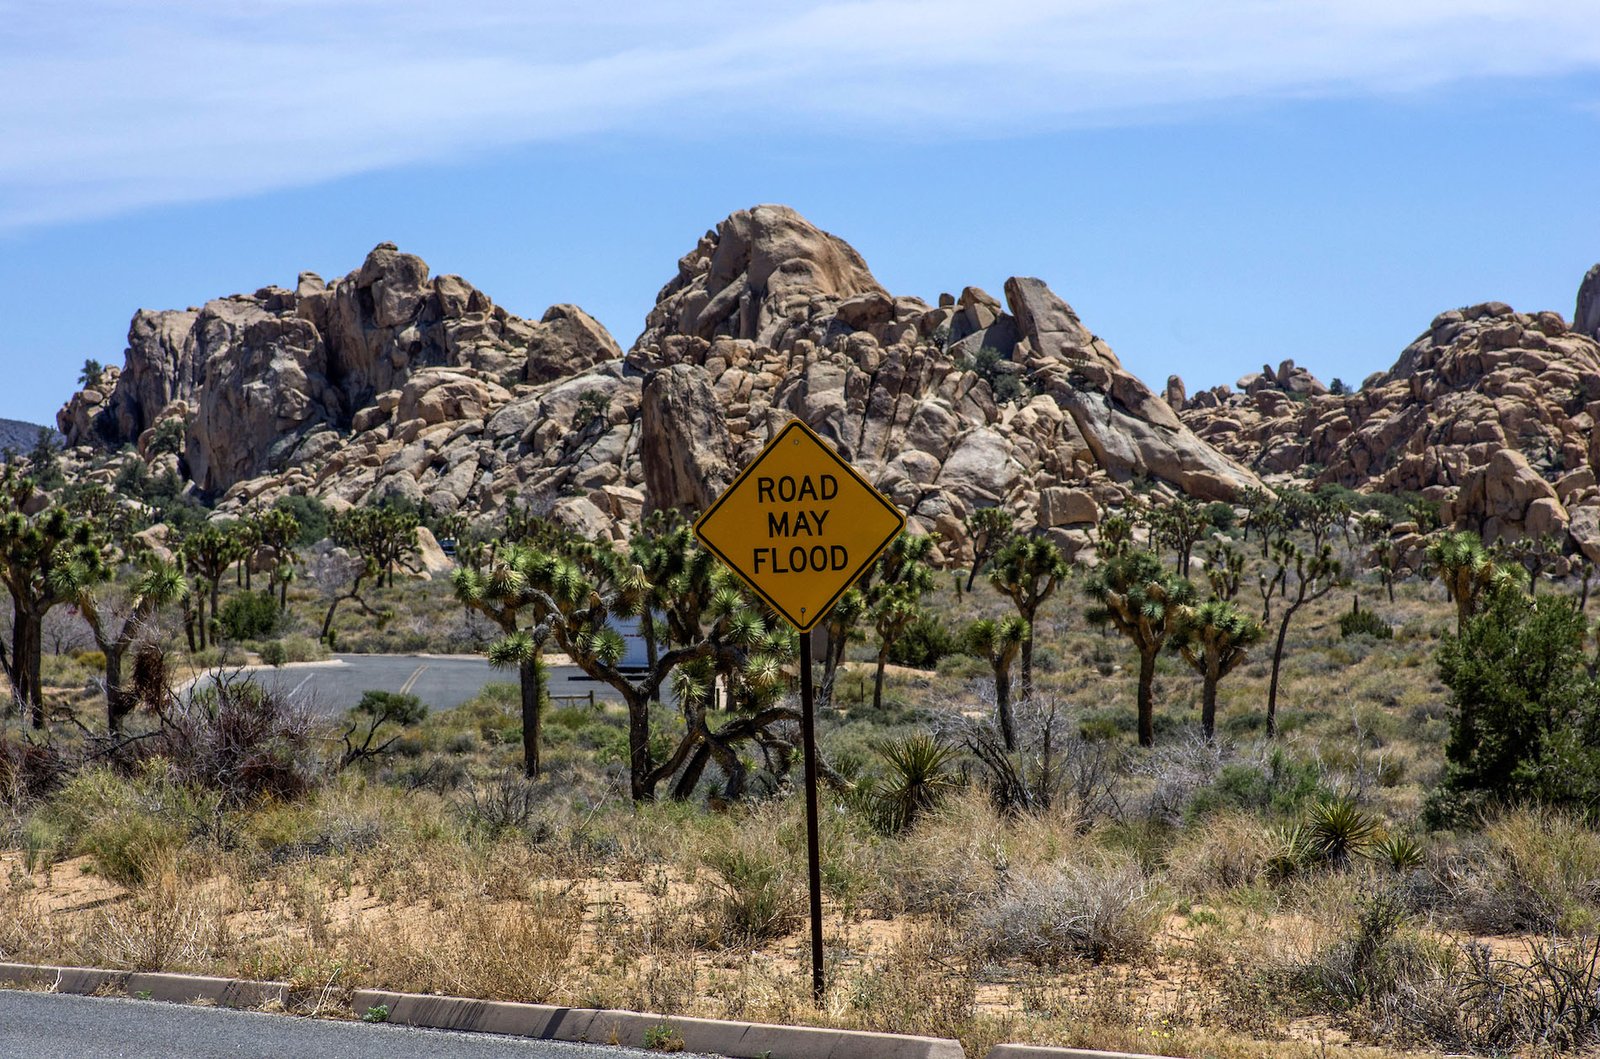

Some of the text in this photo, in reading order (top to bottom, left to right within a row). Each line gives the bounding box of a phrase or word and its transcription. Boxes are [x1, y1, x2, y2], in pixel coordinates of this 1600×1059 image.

[757, 474, 839, 503] ROAD
[767, 510, 830, 538] MAY
[752, 545, 849, 574] FLOOD
